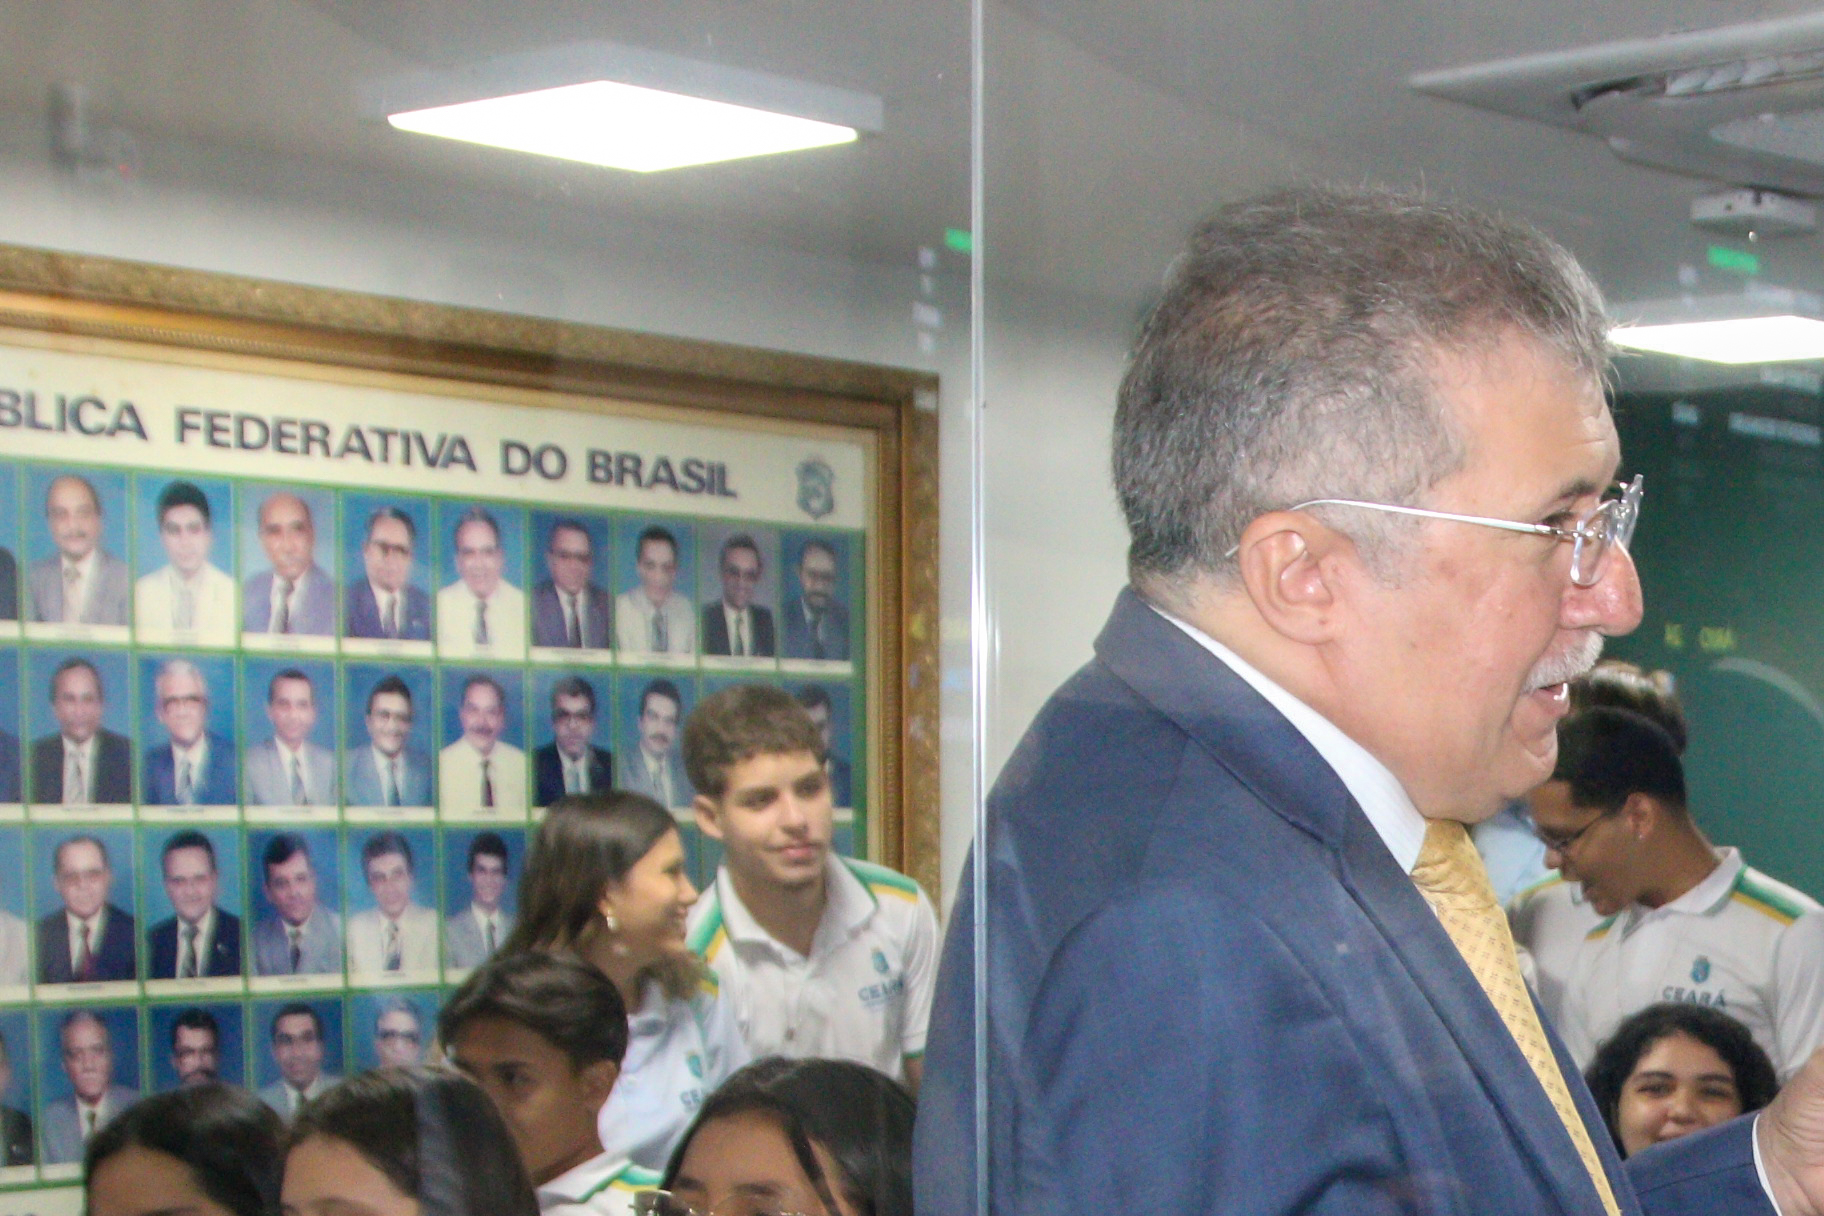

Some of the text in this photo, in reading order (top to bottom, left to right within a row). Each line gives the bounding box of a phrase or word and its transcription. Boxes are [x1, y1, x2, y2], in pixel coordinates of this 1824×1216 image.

[174, 407, 478, 473] FEDERATIVA
[500, 439, 568, 481] DO
[586, 447, 738, 498] BRASIL
